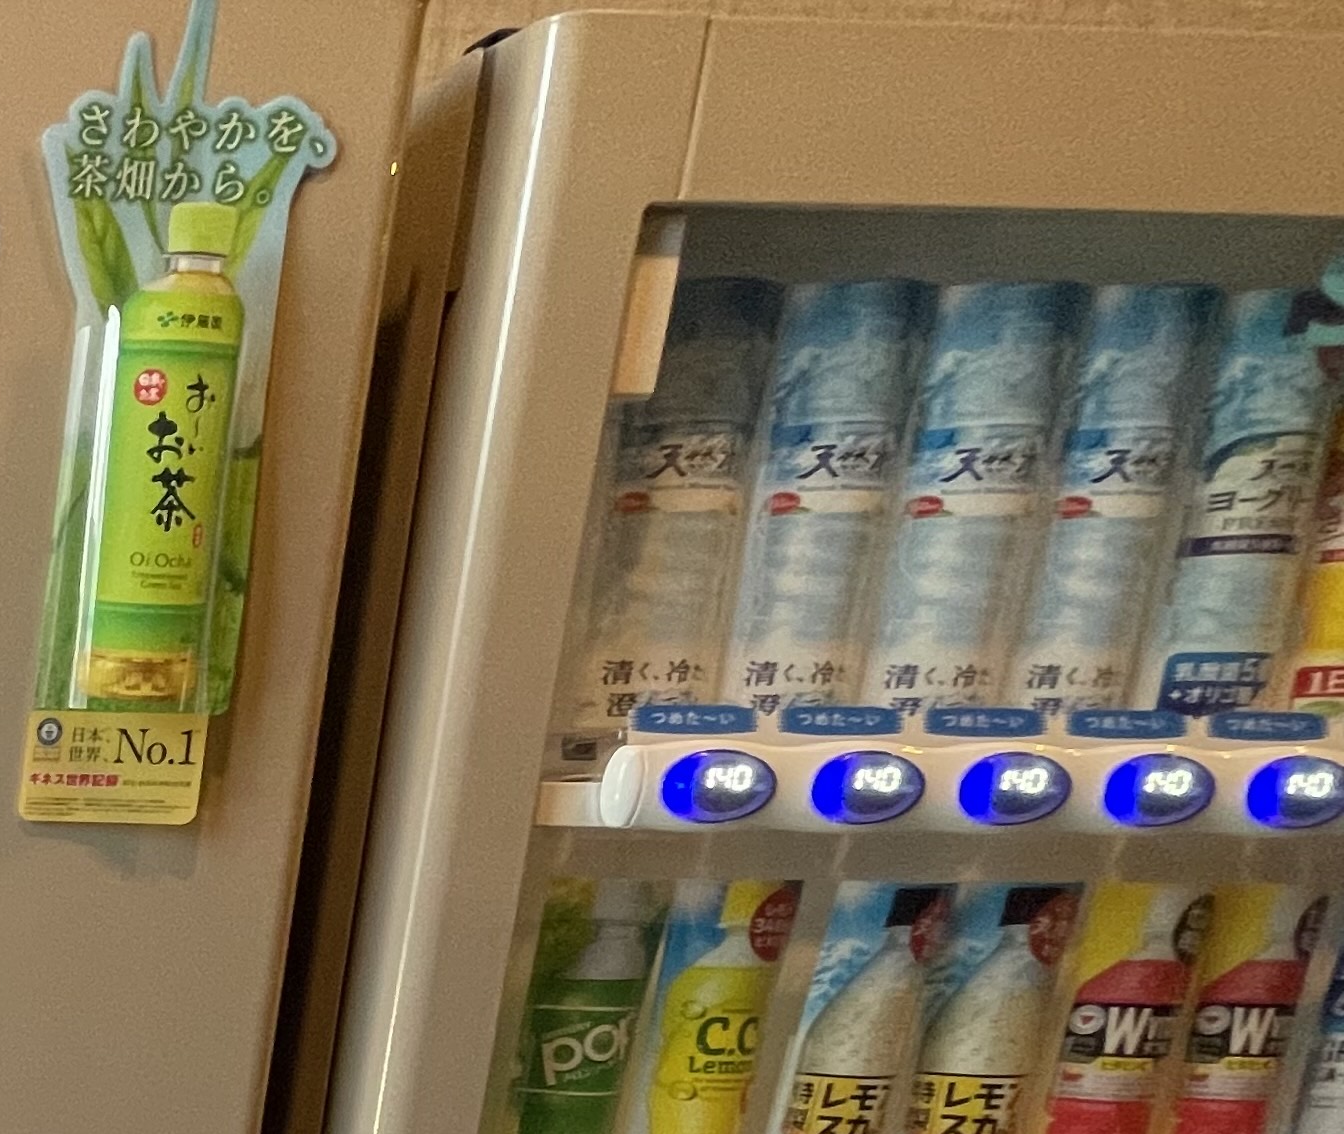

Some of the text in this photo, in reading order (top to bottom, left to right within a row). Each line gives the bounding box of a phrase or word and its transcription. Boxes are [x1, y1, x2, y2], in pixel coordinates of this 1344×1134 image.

[81, 104, 325, 154] さわやかを、
[72, 155, 271, 205] 茶畑から。
[114, 728, 198, 766] No.1
